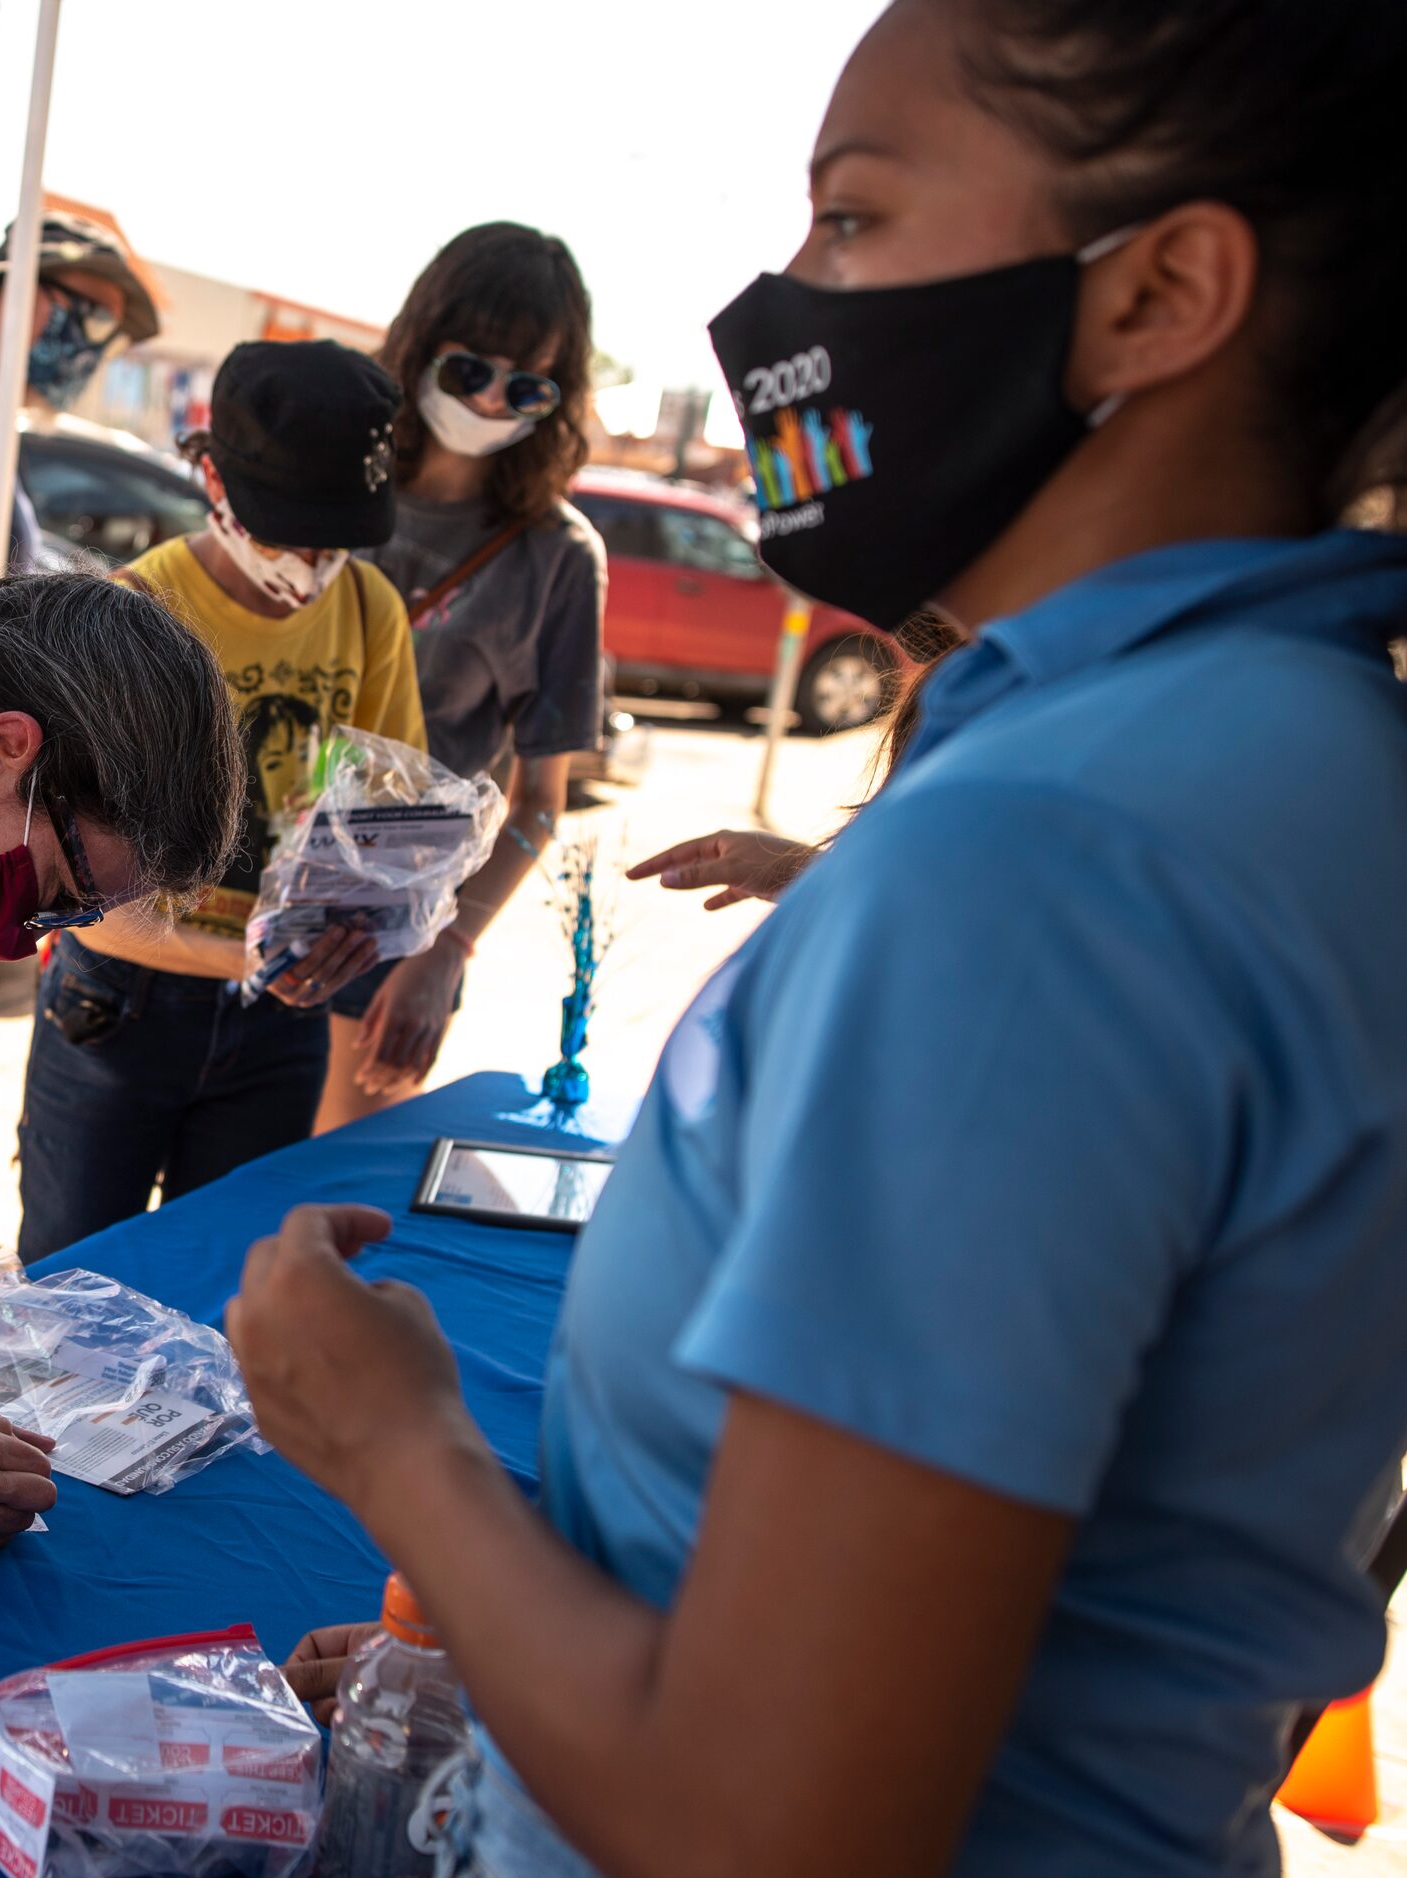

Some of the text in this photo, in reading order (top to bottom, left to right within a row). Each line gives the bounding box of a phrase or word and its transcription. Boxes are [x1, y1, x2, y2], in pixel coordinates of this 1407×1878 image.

[743, 345, 832, 414] 2020
[146, 1408, 183, 1428] POR
[117, 1804, 200, 1828] TICKET
[229, 1811, 305, 1840] TICKET
